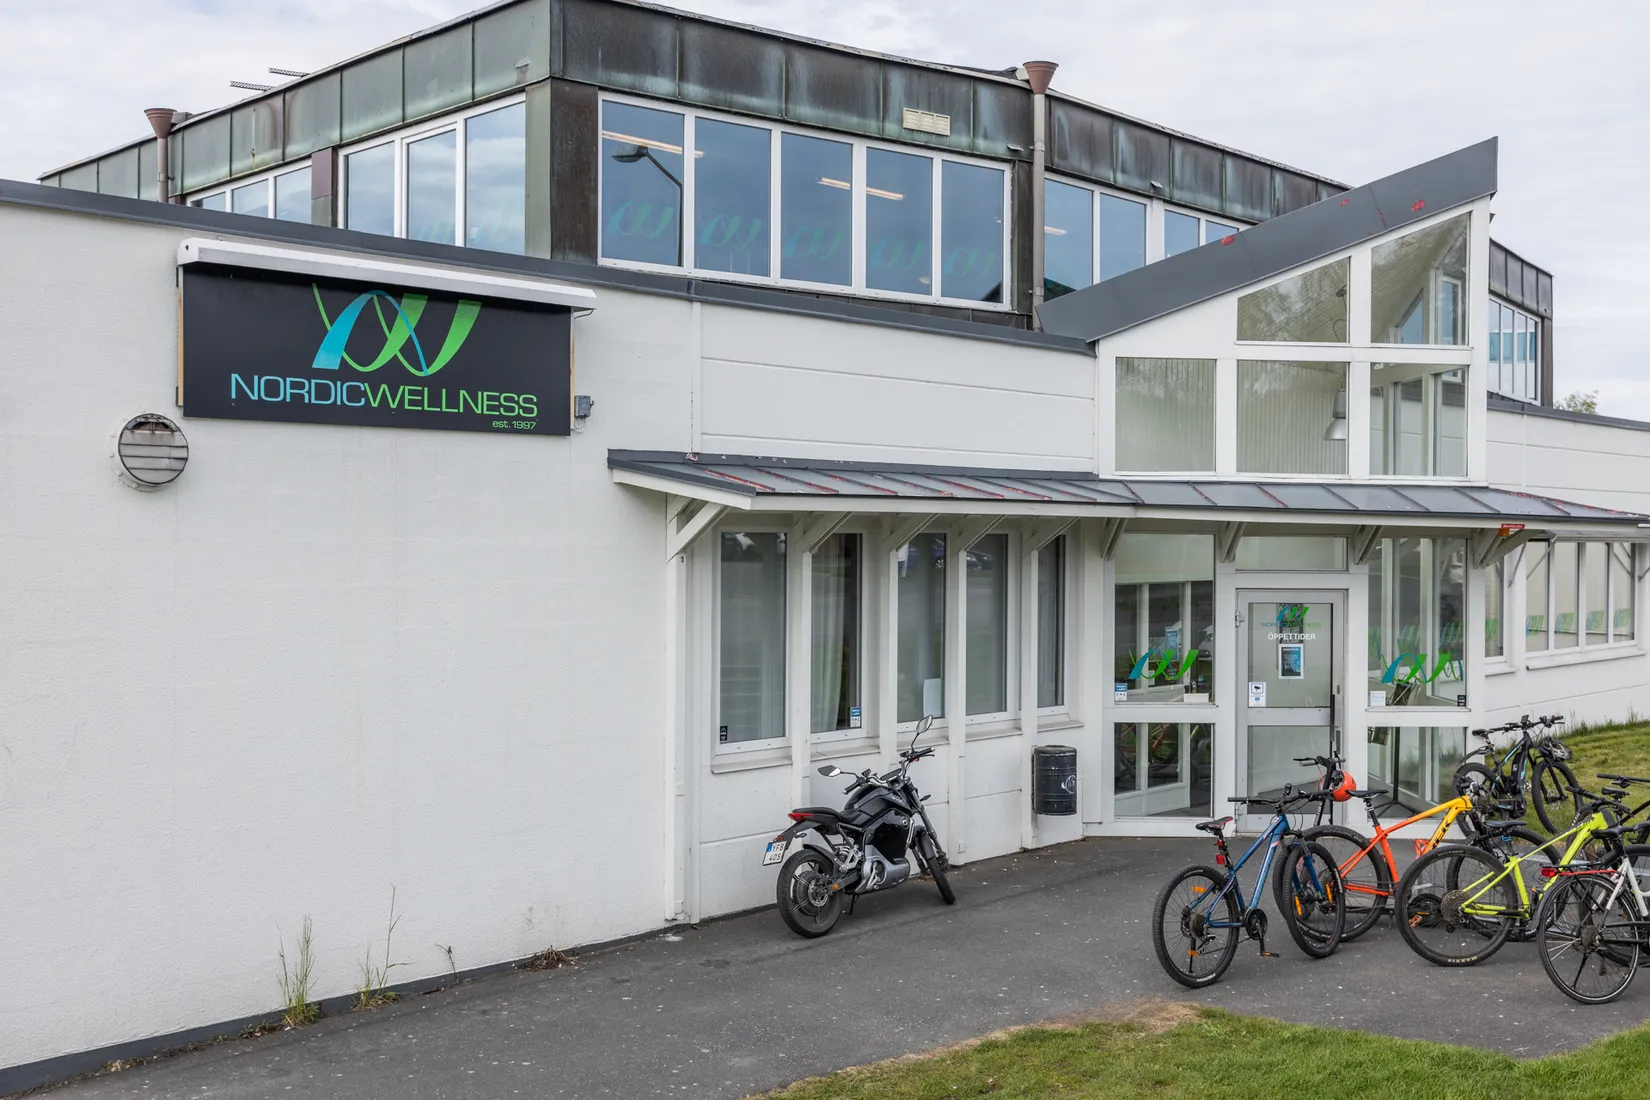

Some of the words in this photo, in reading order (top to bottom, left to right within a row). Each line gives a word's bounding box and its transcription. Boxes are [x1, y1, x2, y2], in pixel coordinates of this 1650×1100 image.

[231, 373, 537, 417] NORDICWELLNESS
[492, 420, 511, 428] est.
[512, 420, 537, 430] 1997
[1268, 632, 1315, 640] ÖPPETTIDER
